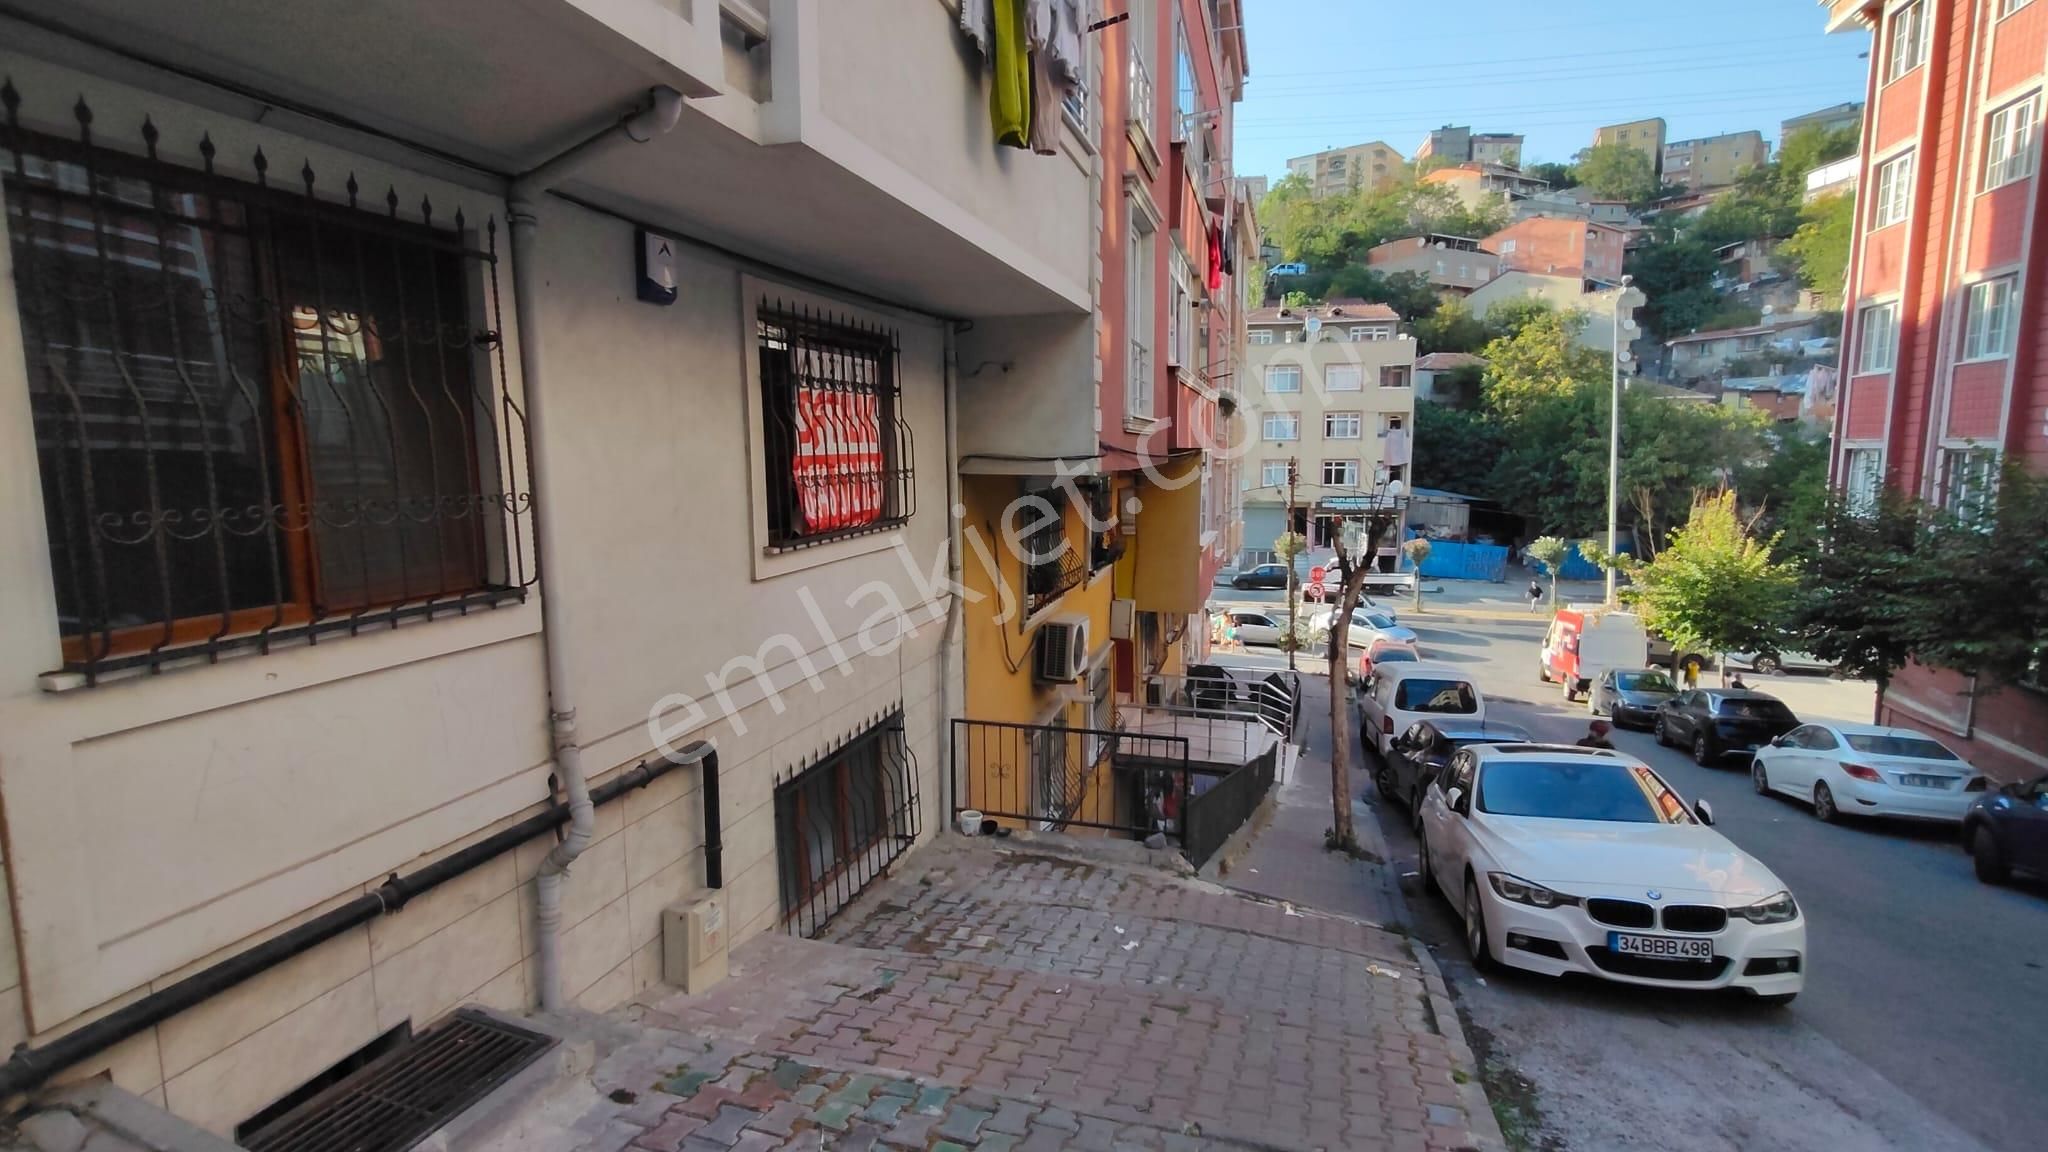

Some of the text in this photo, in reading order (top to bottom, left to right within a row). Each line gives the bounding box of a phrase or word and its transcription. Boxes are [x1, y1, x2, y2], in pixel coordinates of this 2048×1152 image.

[1620, 936, 1710, 957] 34 BBB 498
